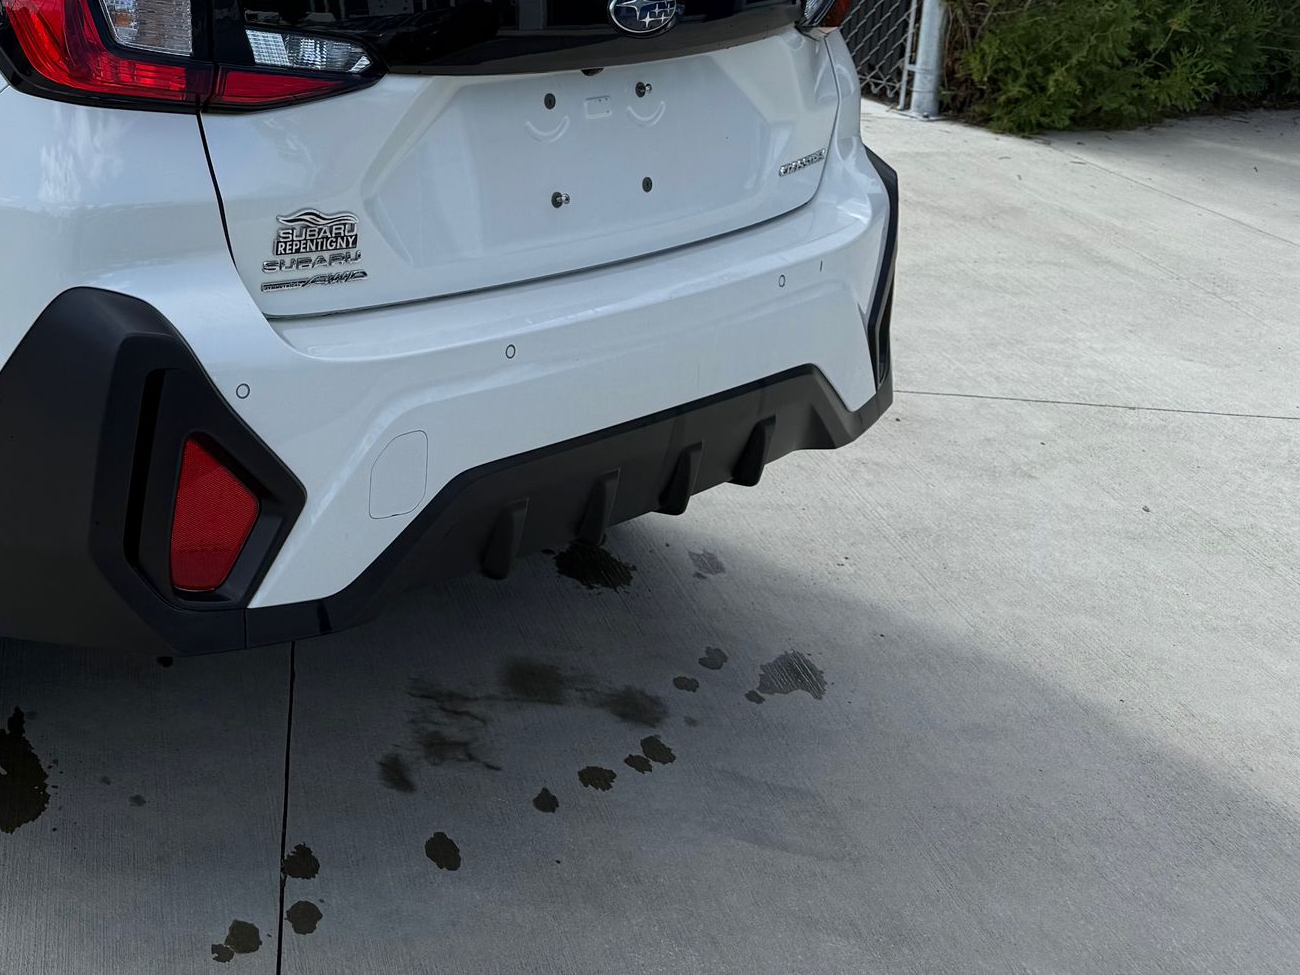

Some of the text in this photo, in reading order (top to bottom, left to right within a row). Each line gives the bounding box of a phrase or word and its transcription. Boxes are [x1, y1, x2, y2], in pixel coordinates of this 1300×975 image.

[278, 224, 357, 241] SUBARU
[277, 236, 356, 254] REPENTIGNY
[262, 250, 362, 273] SUBARU
